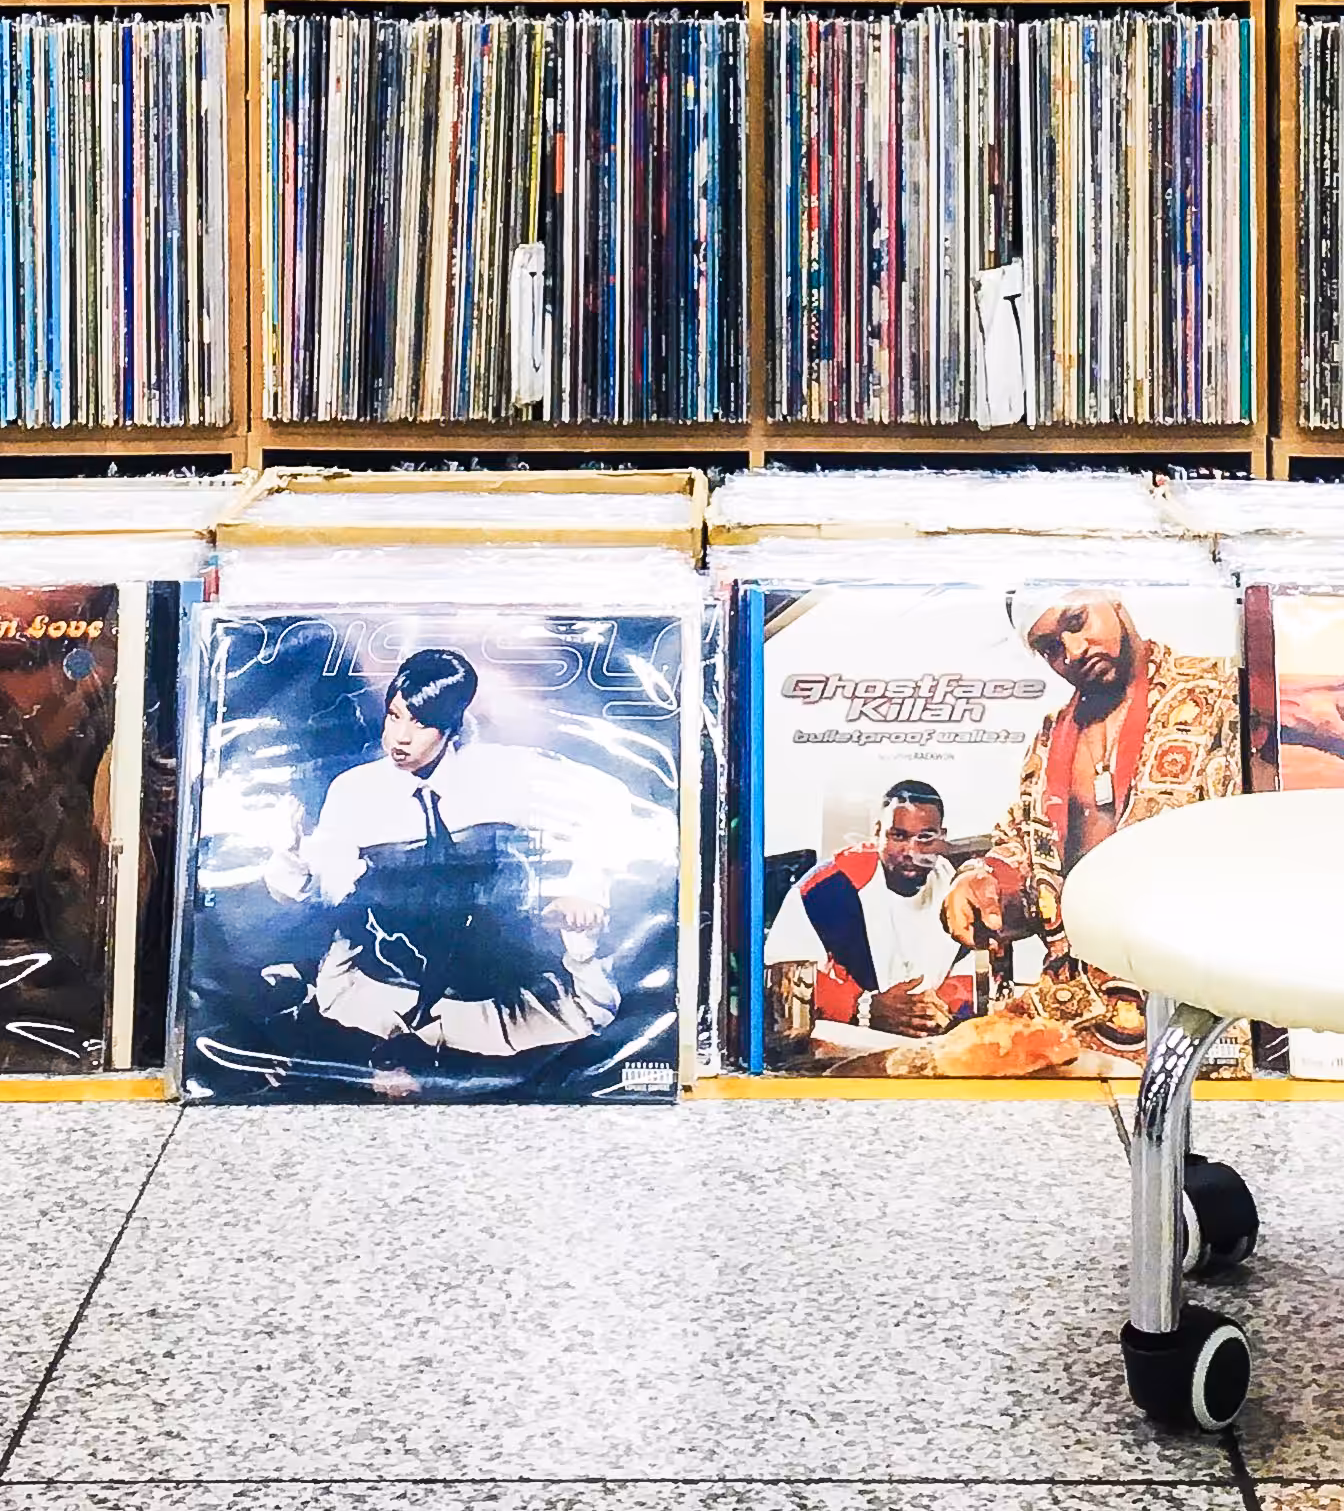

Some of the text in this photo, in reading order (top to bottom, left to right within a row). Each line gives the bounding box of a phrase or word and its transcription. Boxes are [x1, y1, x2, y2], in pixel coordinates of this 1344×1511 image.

[26, 615, 104, 639] Love
[781, 673, 1047, 705] Ghostface
[846, 697, 986, 723] Killah
[792, 729, 1026, 747] bulletproof wallets
